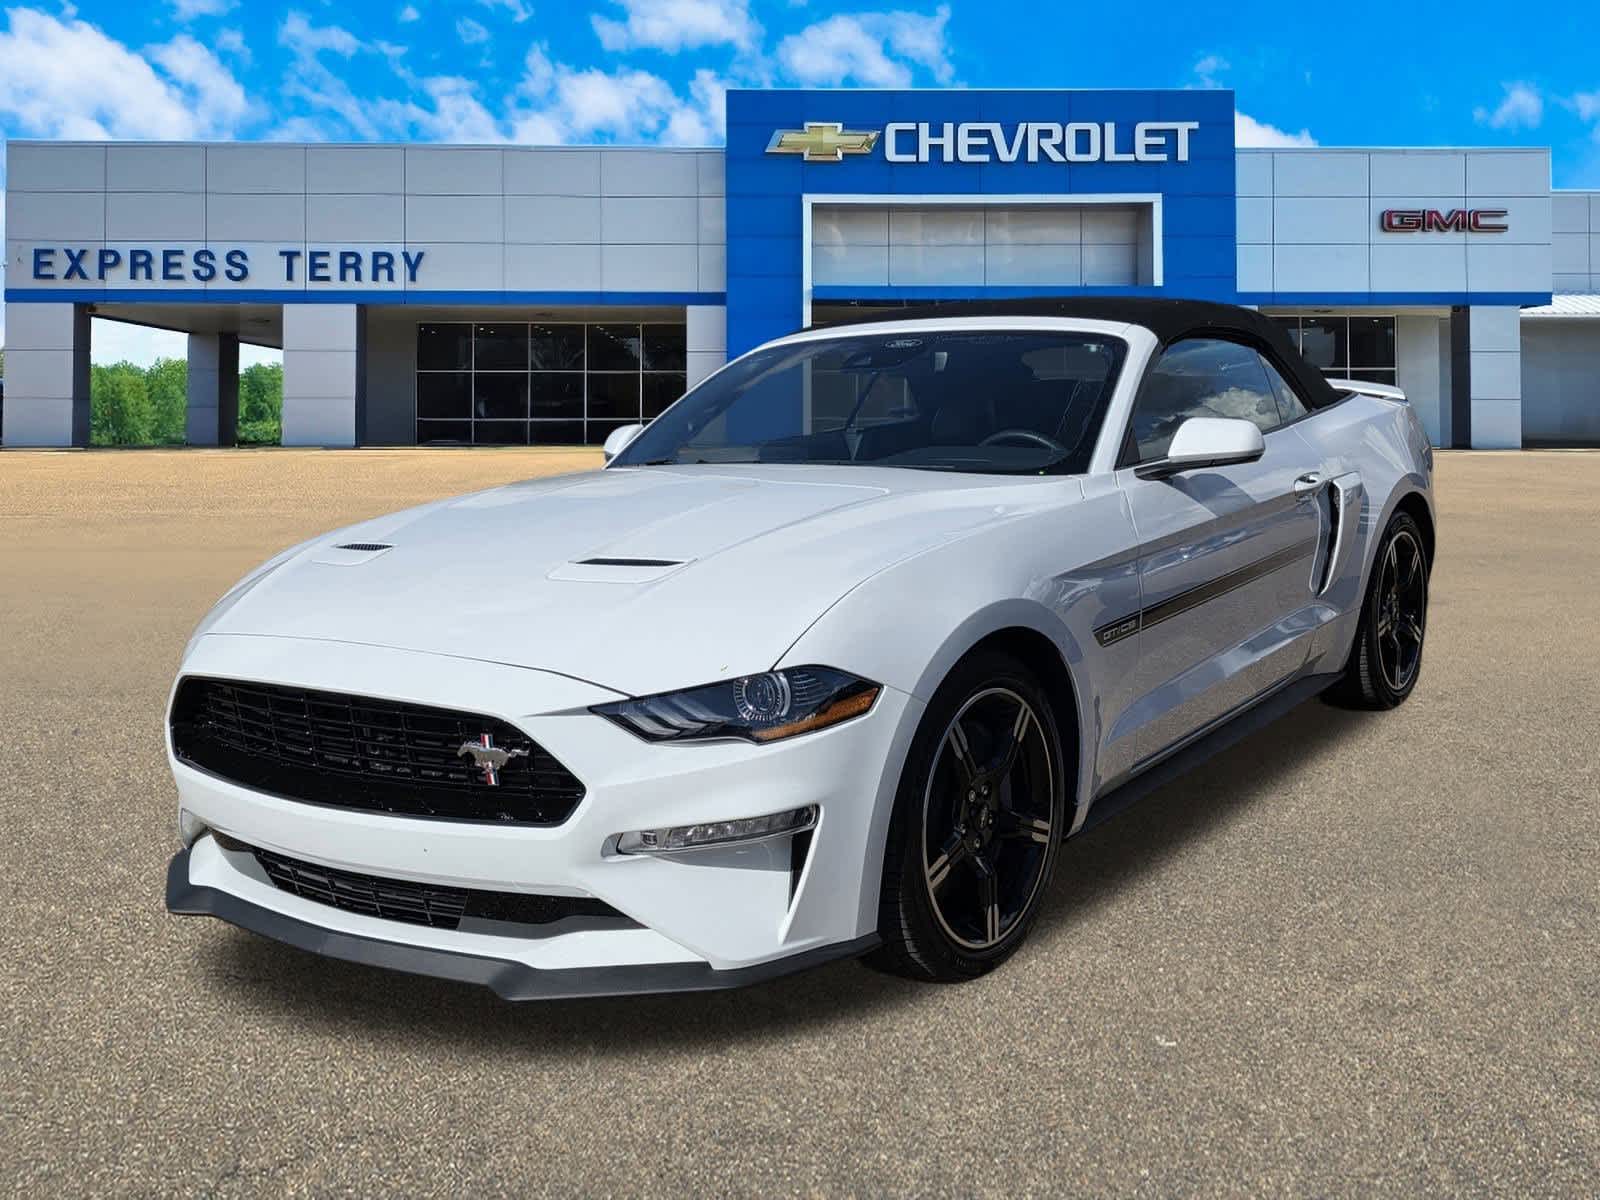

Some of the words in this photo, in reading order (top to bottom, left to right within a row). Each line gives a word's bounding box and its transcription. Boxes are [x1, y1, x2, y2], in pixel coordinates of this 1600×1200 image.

[885, 122, 1199, 162] CHEVROLET
[1381, 208, 1508, 232] GMC
[32, 248, 249, 282] EXPRESS
[279, 250, 425, 282] TERRY
